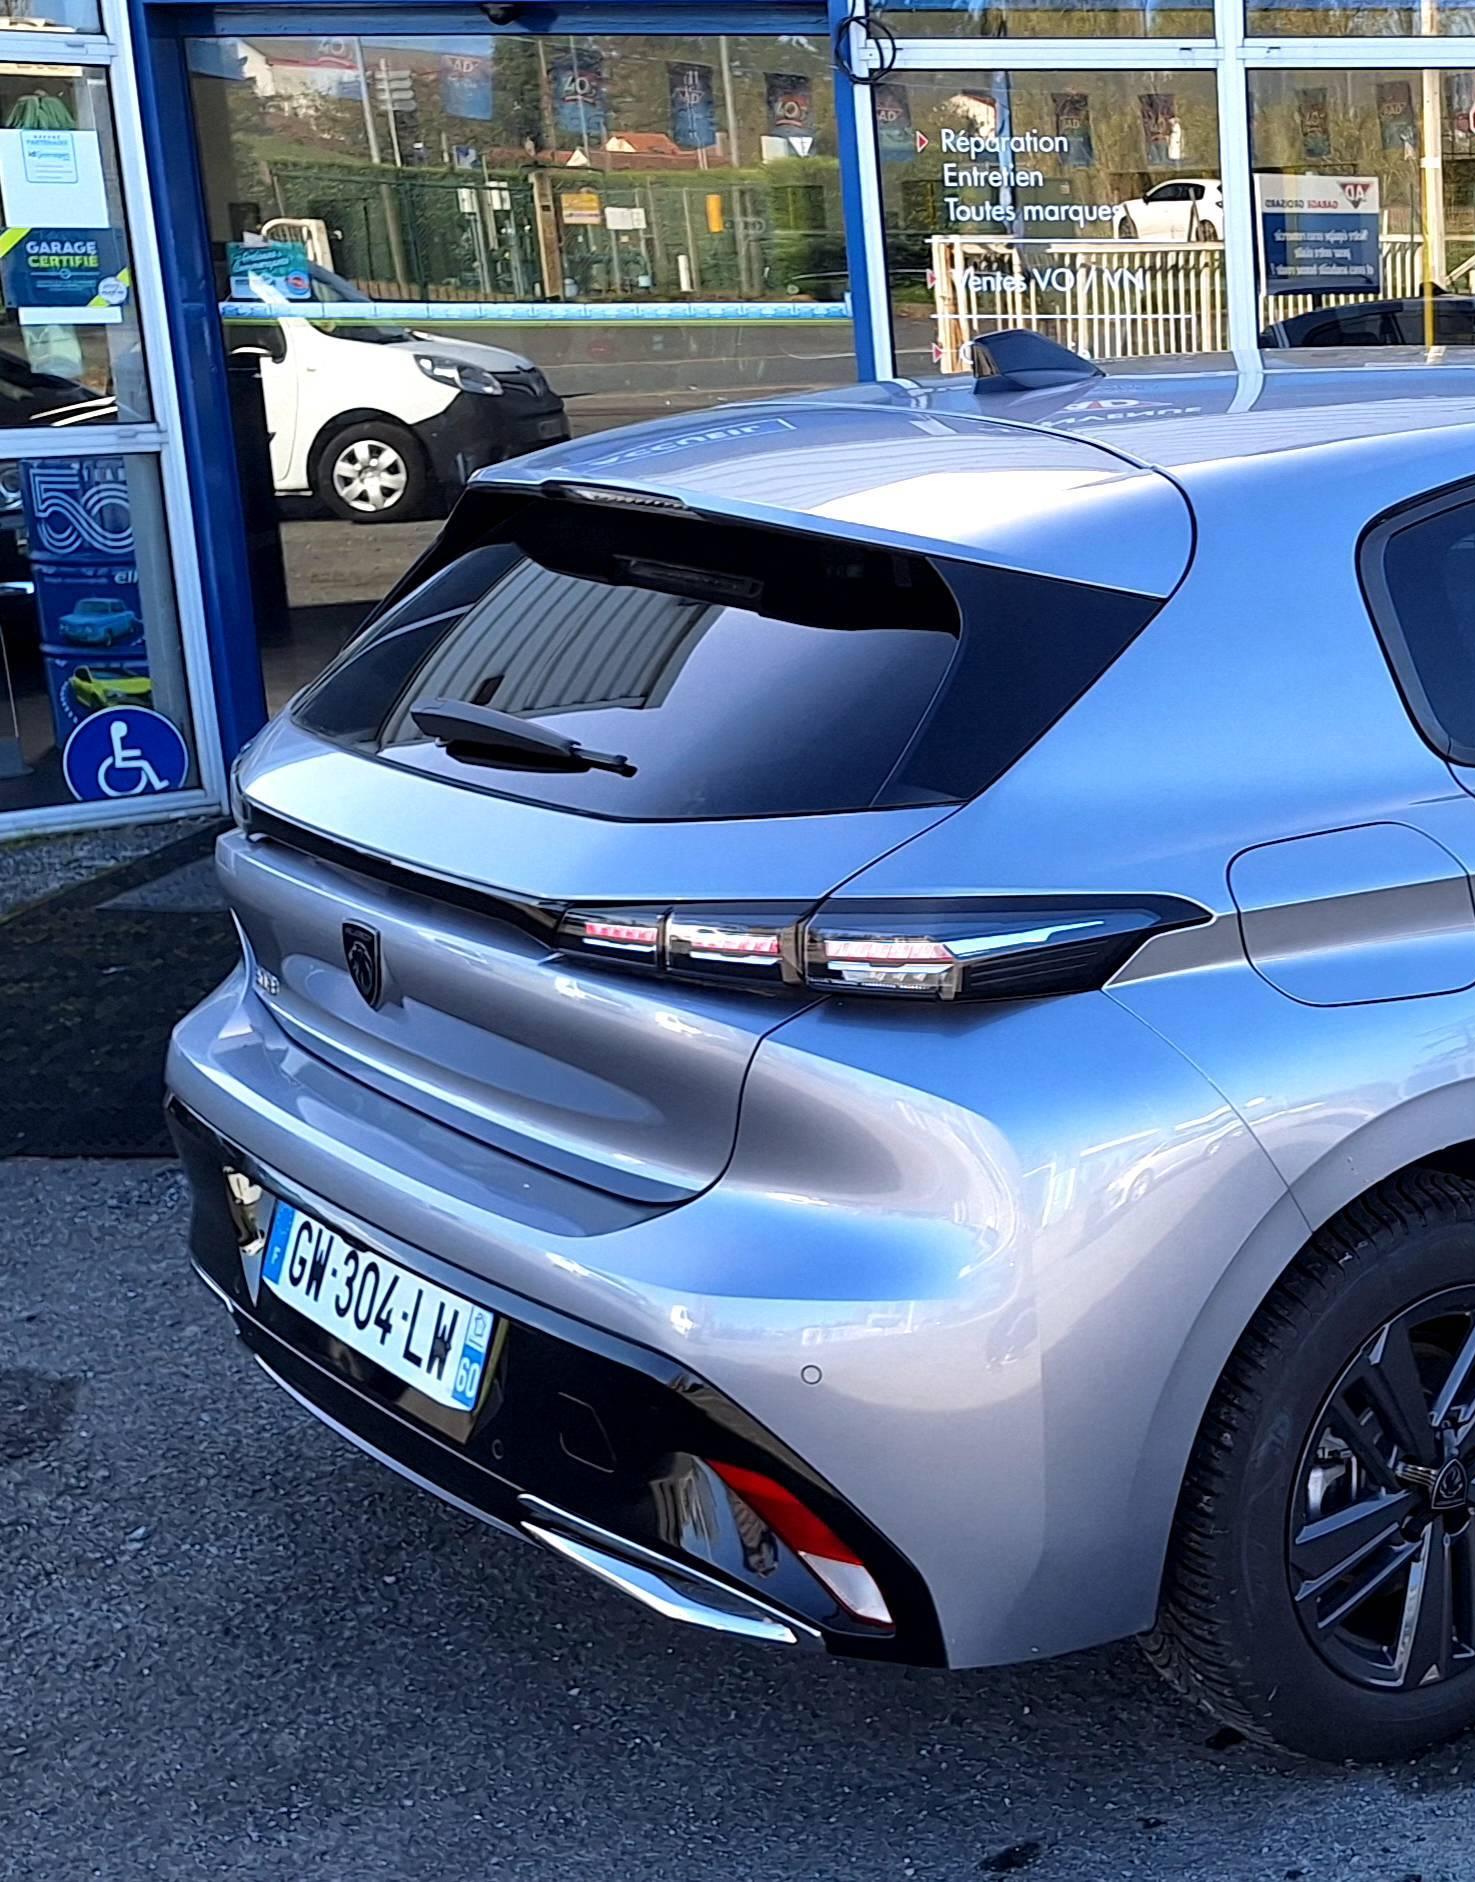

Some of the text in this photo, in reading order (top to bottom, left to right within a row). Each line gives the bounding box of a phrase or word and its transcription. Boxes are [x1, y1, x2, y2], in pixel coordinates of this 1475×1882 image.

[941, 128, 1069, 160] Réparation
[943, 163, 1044, 188] Entretien
[944, 198, 1121, 228] Toutes marques
[26, 241, 98, 254] GARAGE
[956, 269, 1027, 293] Ventes
[1033, 268, 1075, 292] VO
[288, 1220, 460, 1381] GW-304-LW
[456, 1356, 480, 1398] 60
